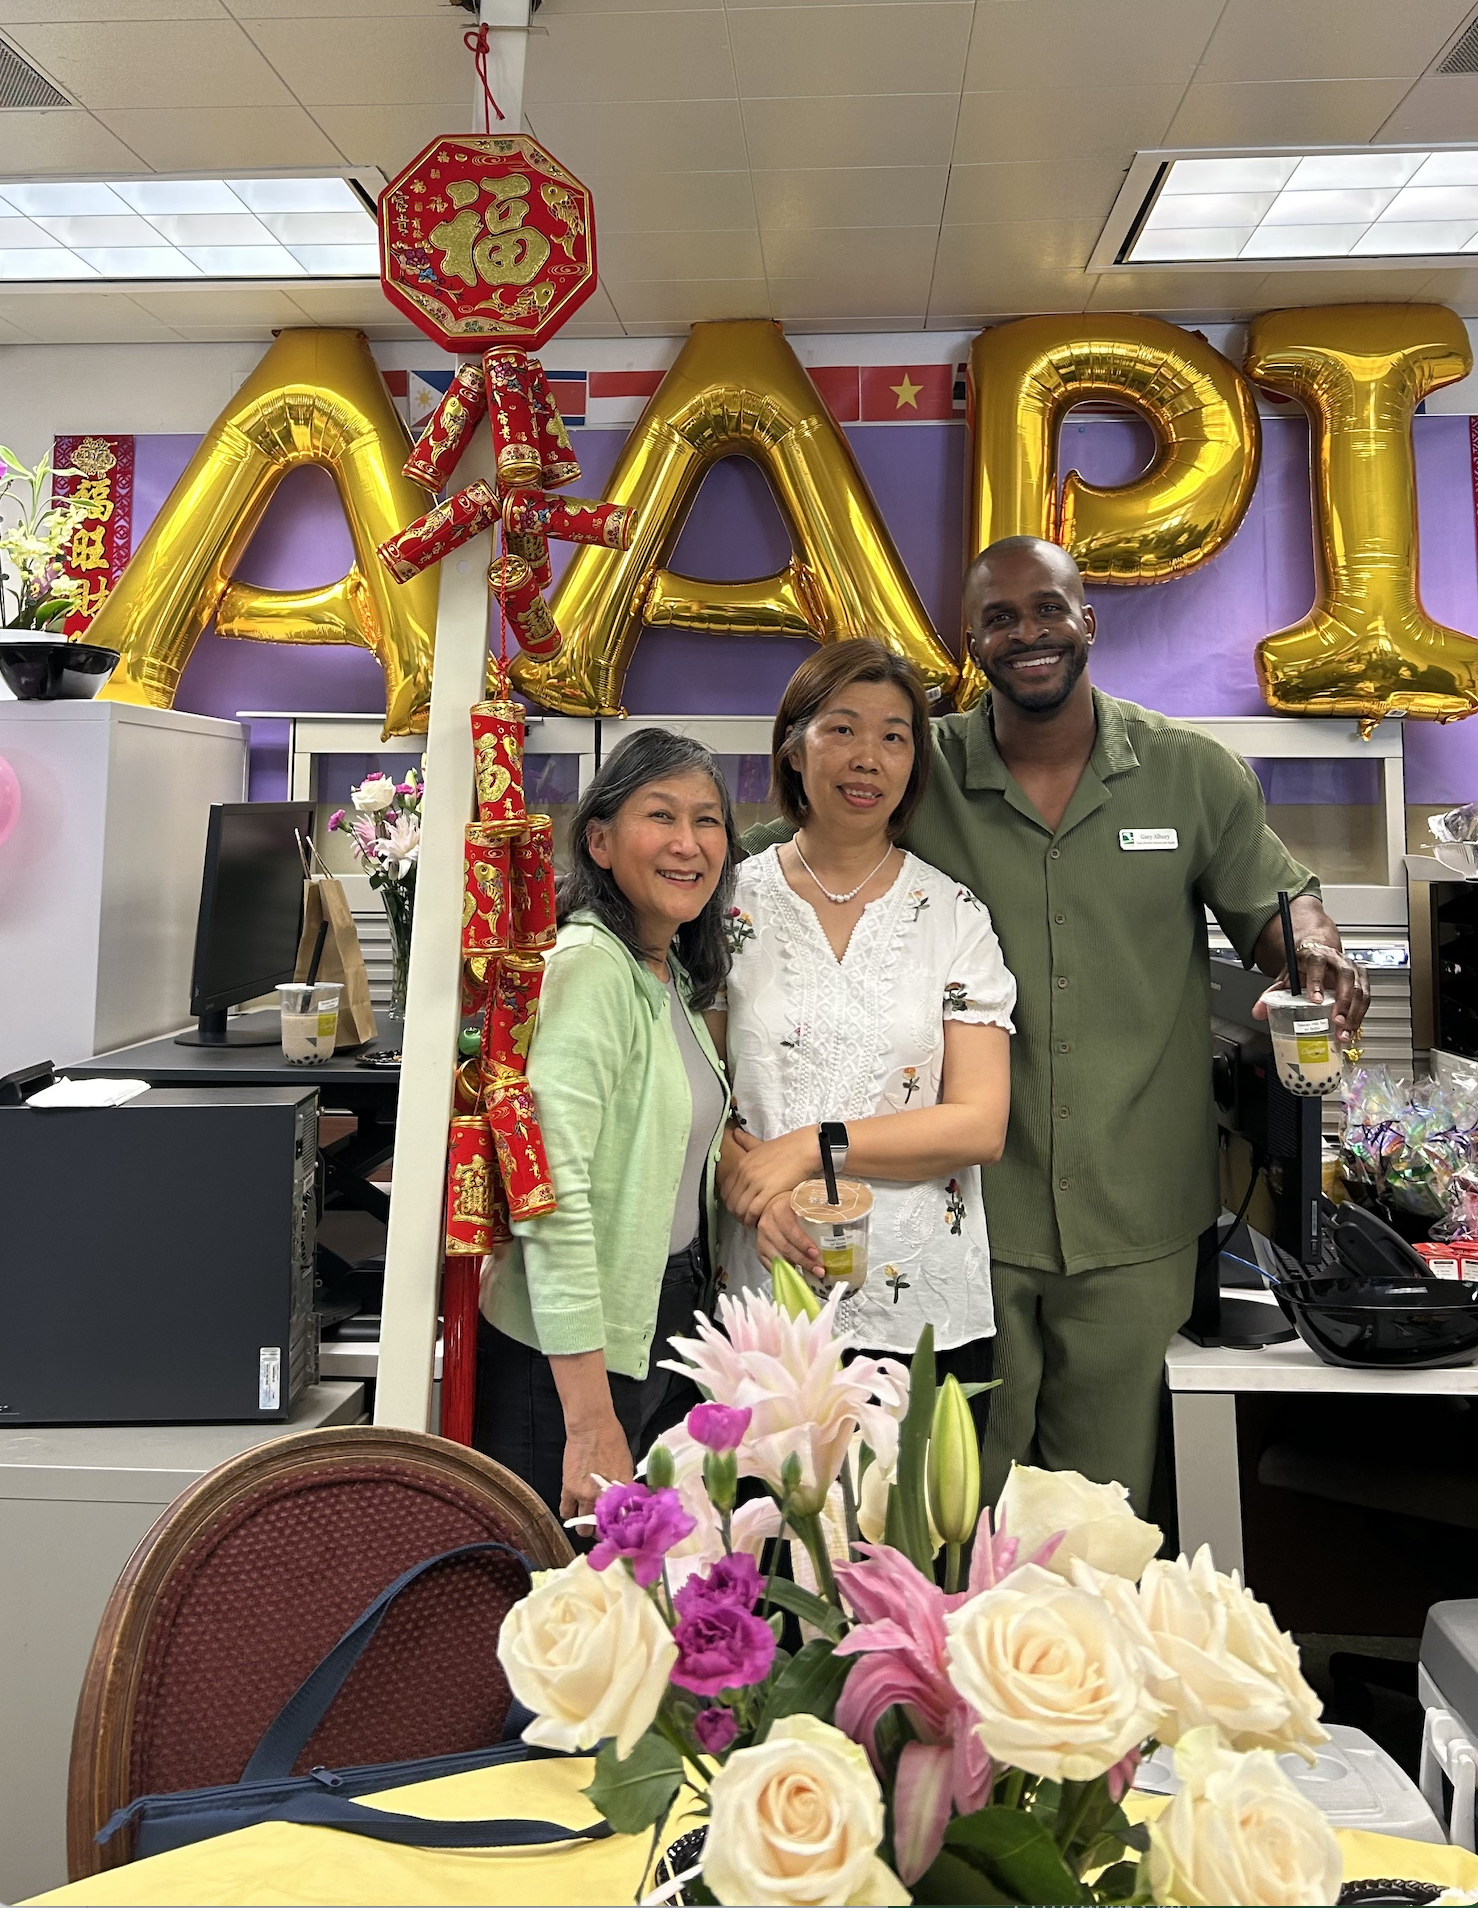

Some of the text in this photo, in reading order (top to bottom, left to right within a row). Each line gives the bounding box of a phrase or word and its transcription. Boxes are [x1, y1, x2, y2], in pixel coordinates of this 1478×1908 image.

[429, 173, 551, 287] 福
[67, 477, 116, 643] 福旺財
[86, 303, 1478, 742] AAPI
